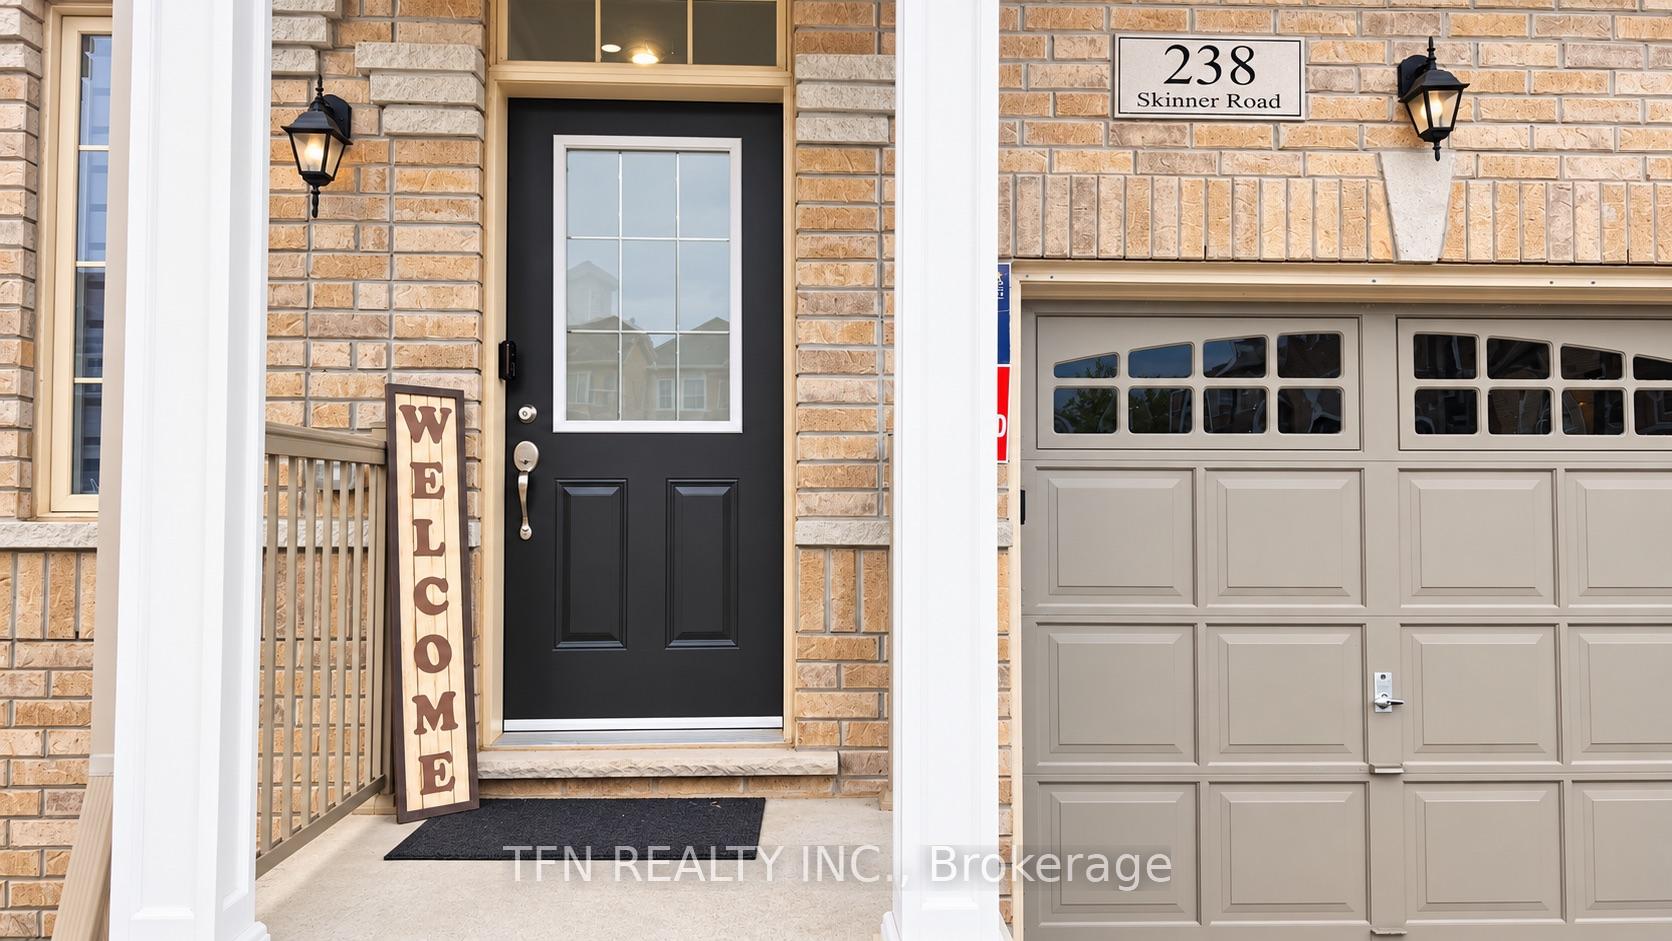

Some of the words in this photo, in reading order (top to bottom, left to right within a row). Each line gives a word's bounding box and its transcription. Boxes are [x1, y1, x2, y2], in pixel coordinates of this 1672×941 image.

[1163, 44, 1256, 86] 238
[1137, 91, 1220, 109] Skinner
[1226, 93, 1282, 109] Road
[398, 404, 459, 796] WELCOME
